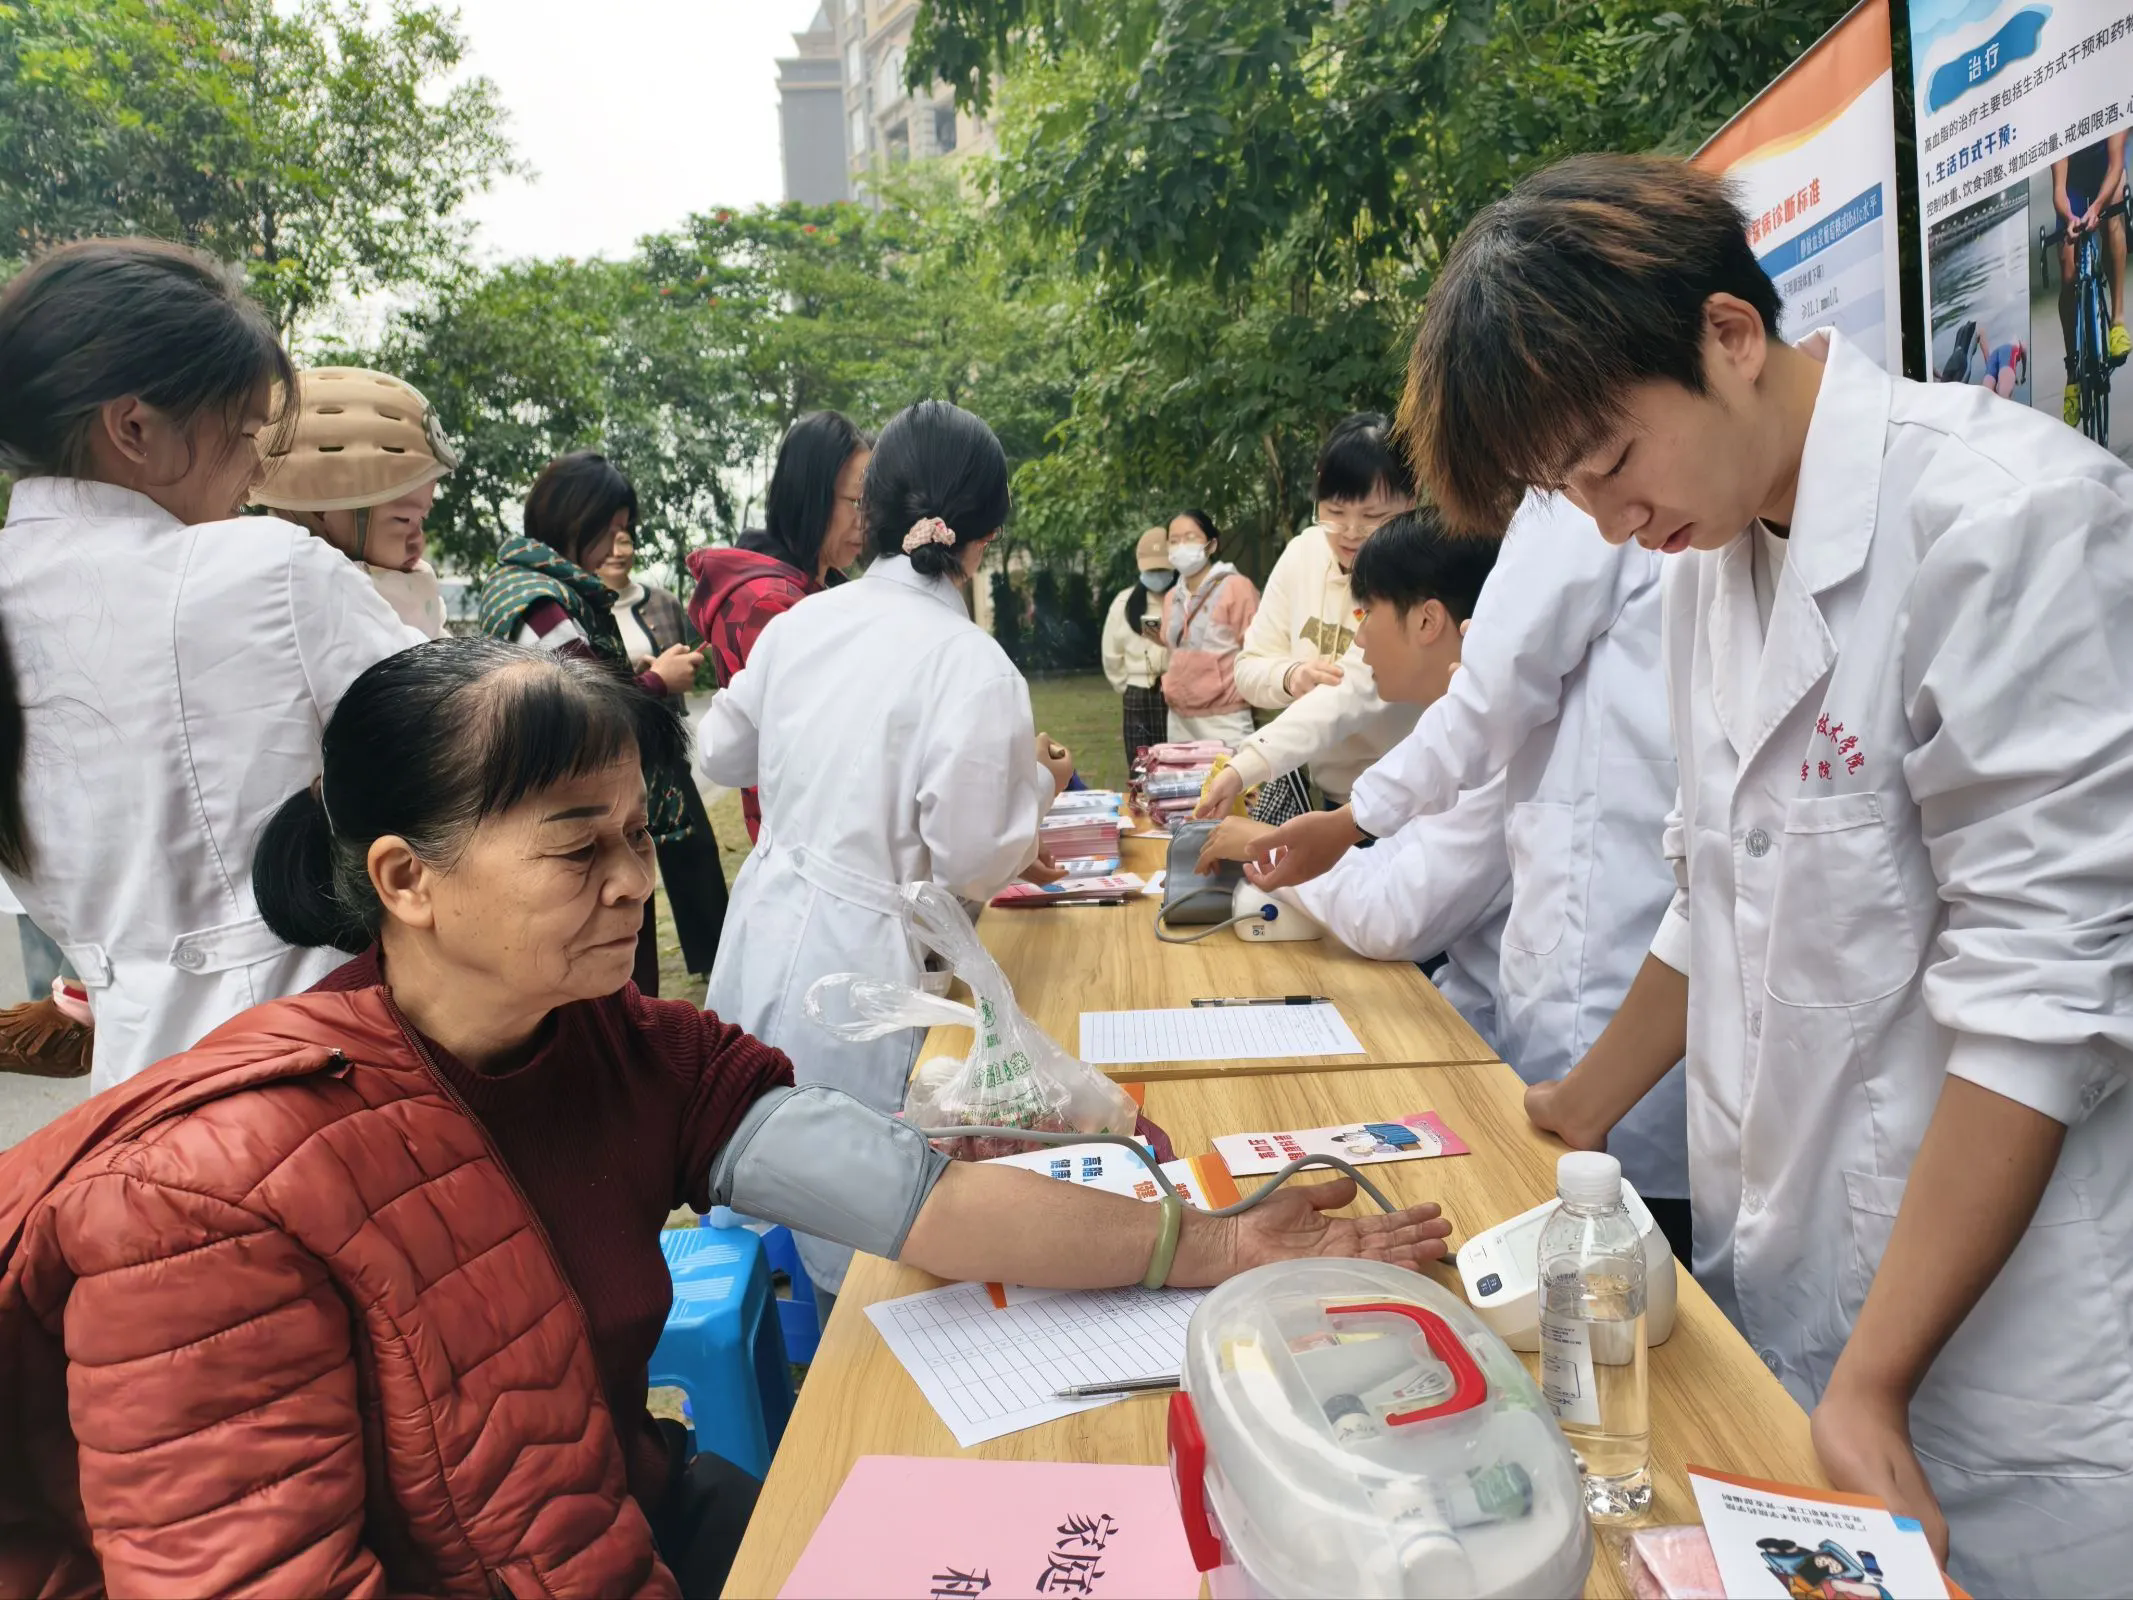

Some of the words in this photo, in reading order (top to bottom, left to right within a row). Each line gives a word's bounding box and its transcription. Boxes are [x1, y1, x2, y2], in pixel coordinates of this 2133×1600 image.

[1968, 42, 2000, 83] 治疗
[1050, 1158, 1072, 1183] 健康
[1082, 1156, 1103, 1182] 高脂
[1036, 1513, 1119, 1600] 家庭
